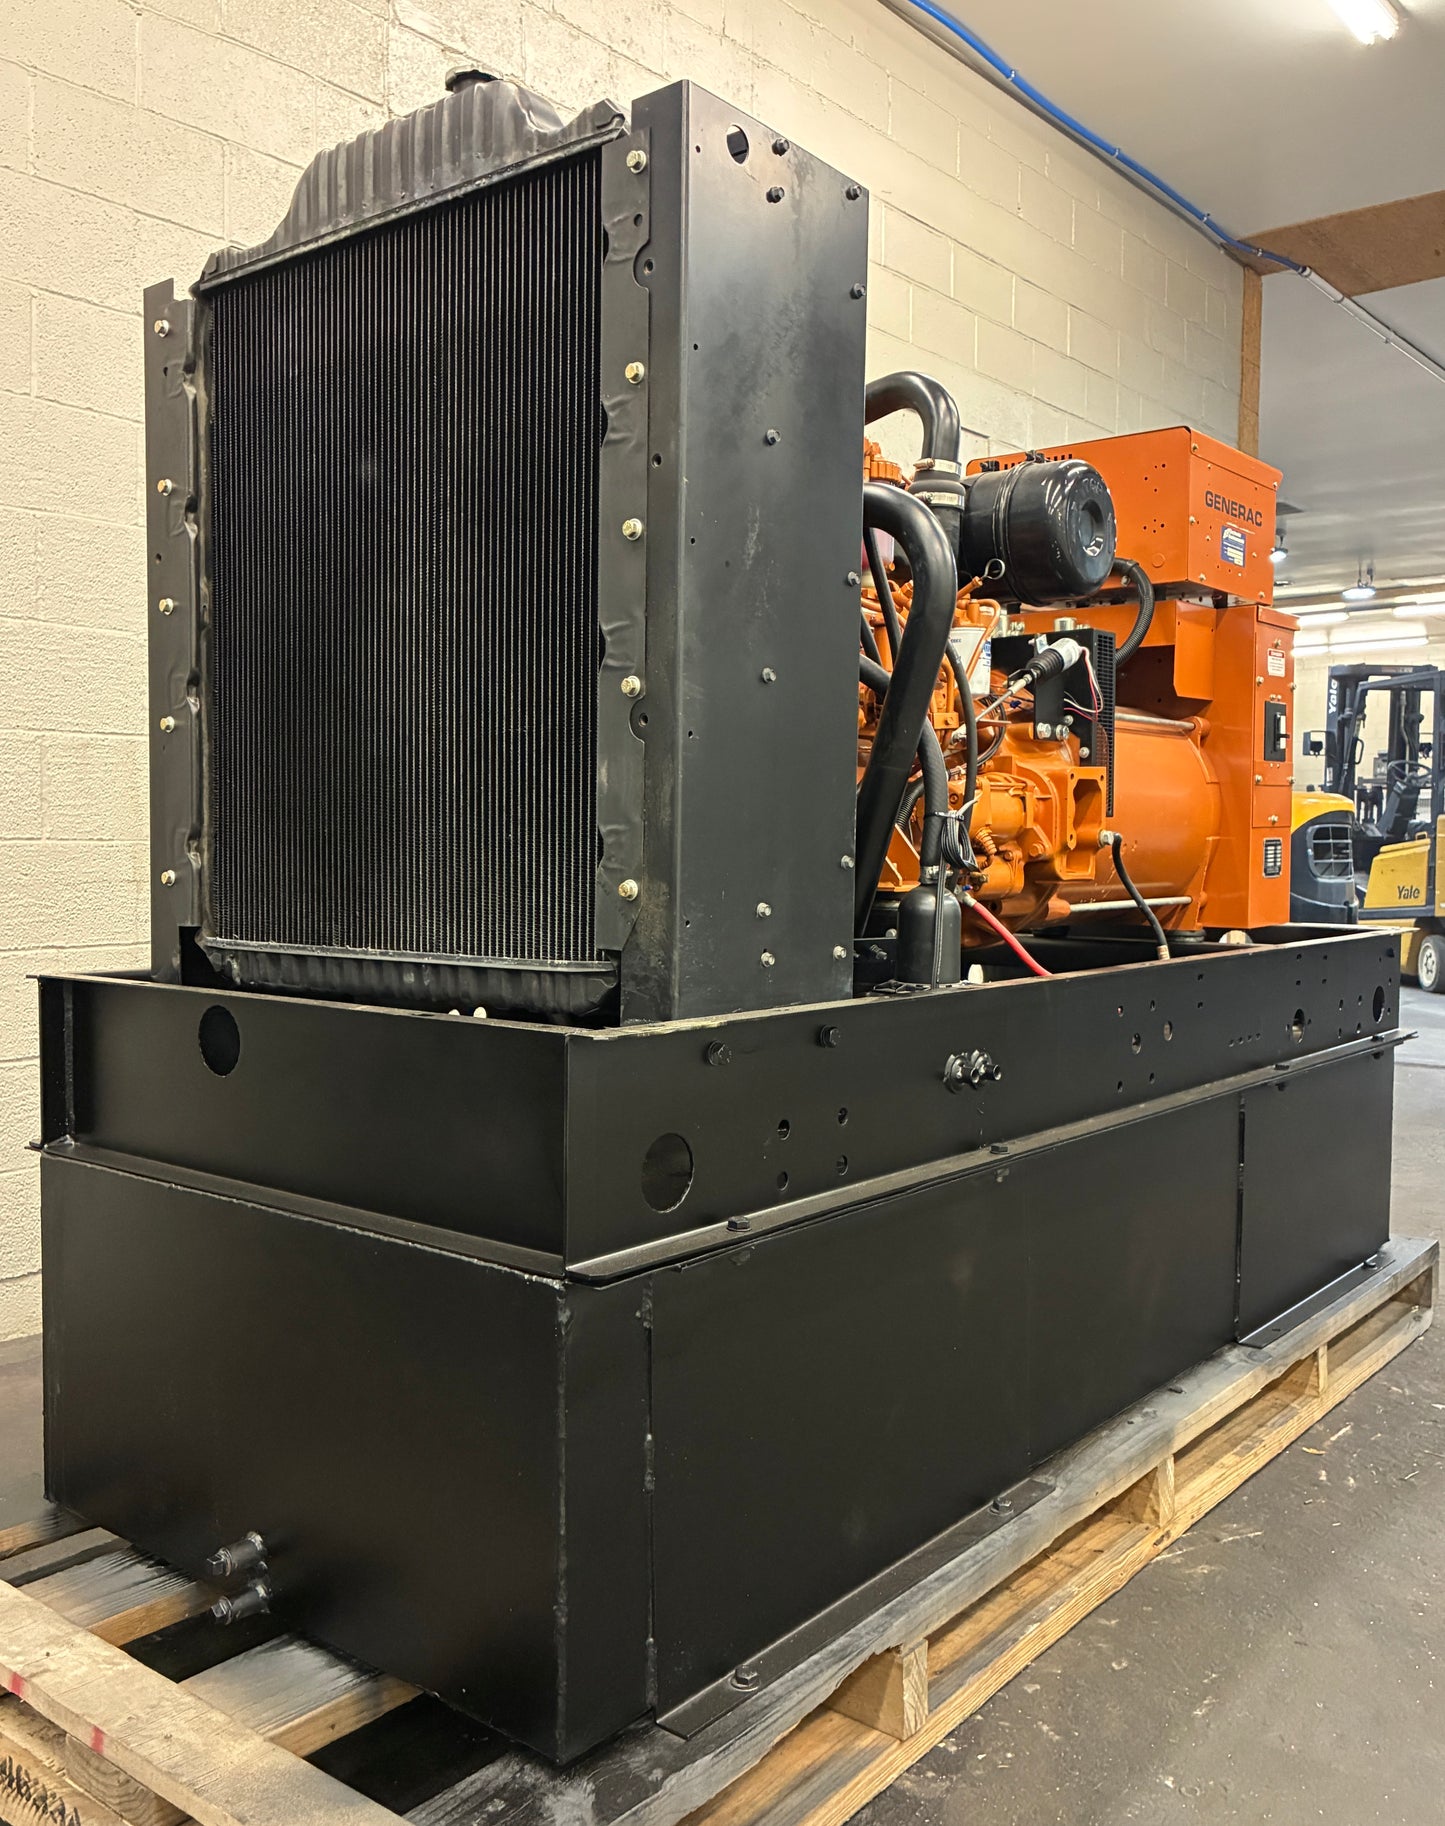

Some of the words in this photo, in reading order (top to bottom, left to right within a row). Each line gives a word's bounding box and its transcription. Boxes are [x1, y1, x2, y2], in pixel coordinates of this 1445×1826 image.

[1205, 490, 1263, 527] GENERAC
[1328, 679, 1338, 714] Yale
[1397, 885, 1420, 900] Yale
